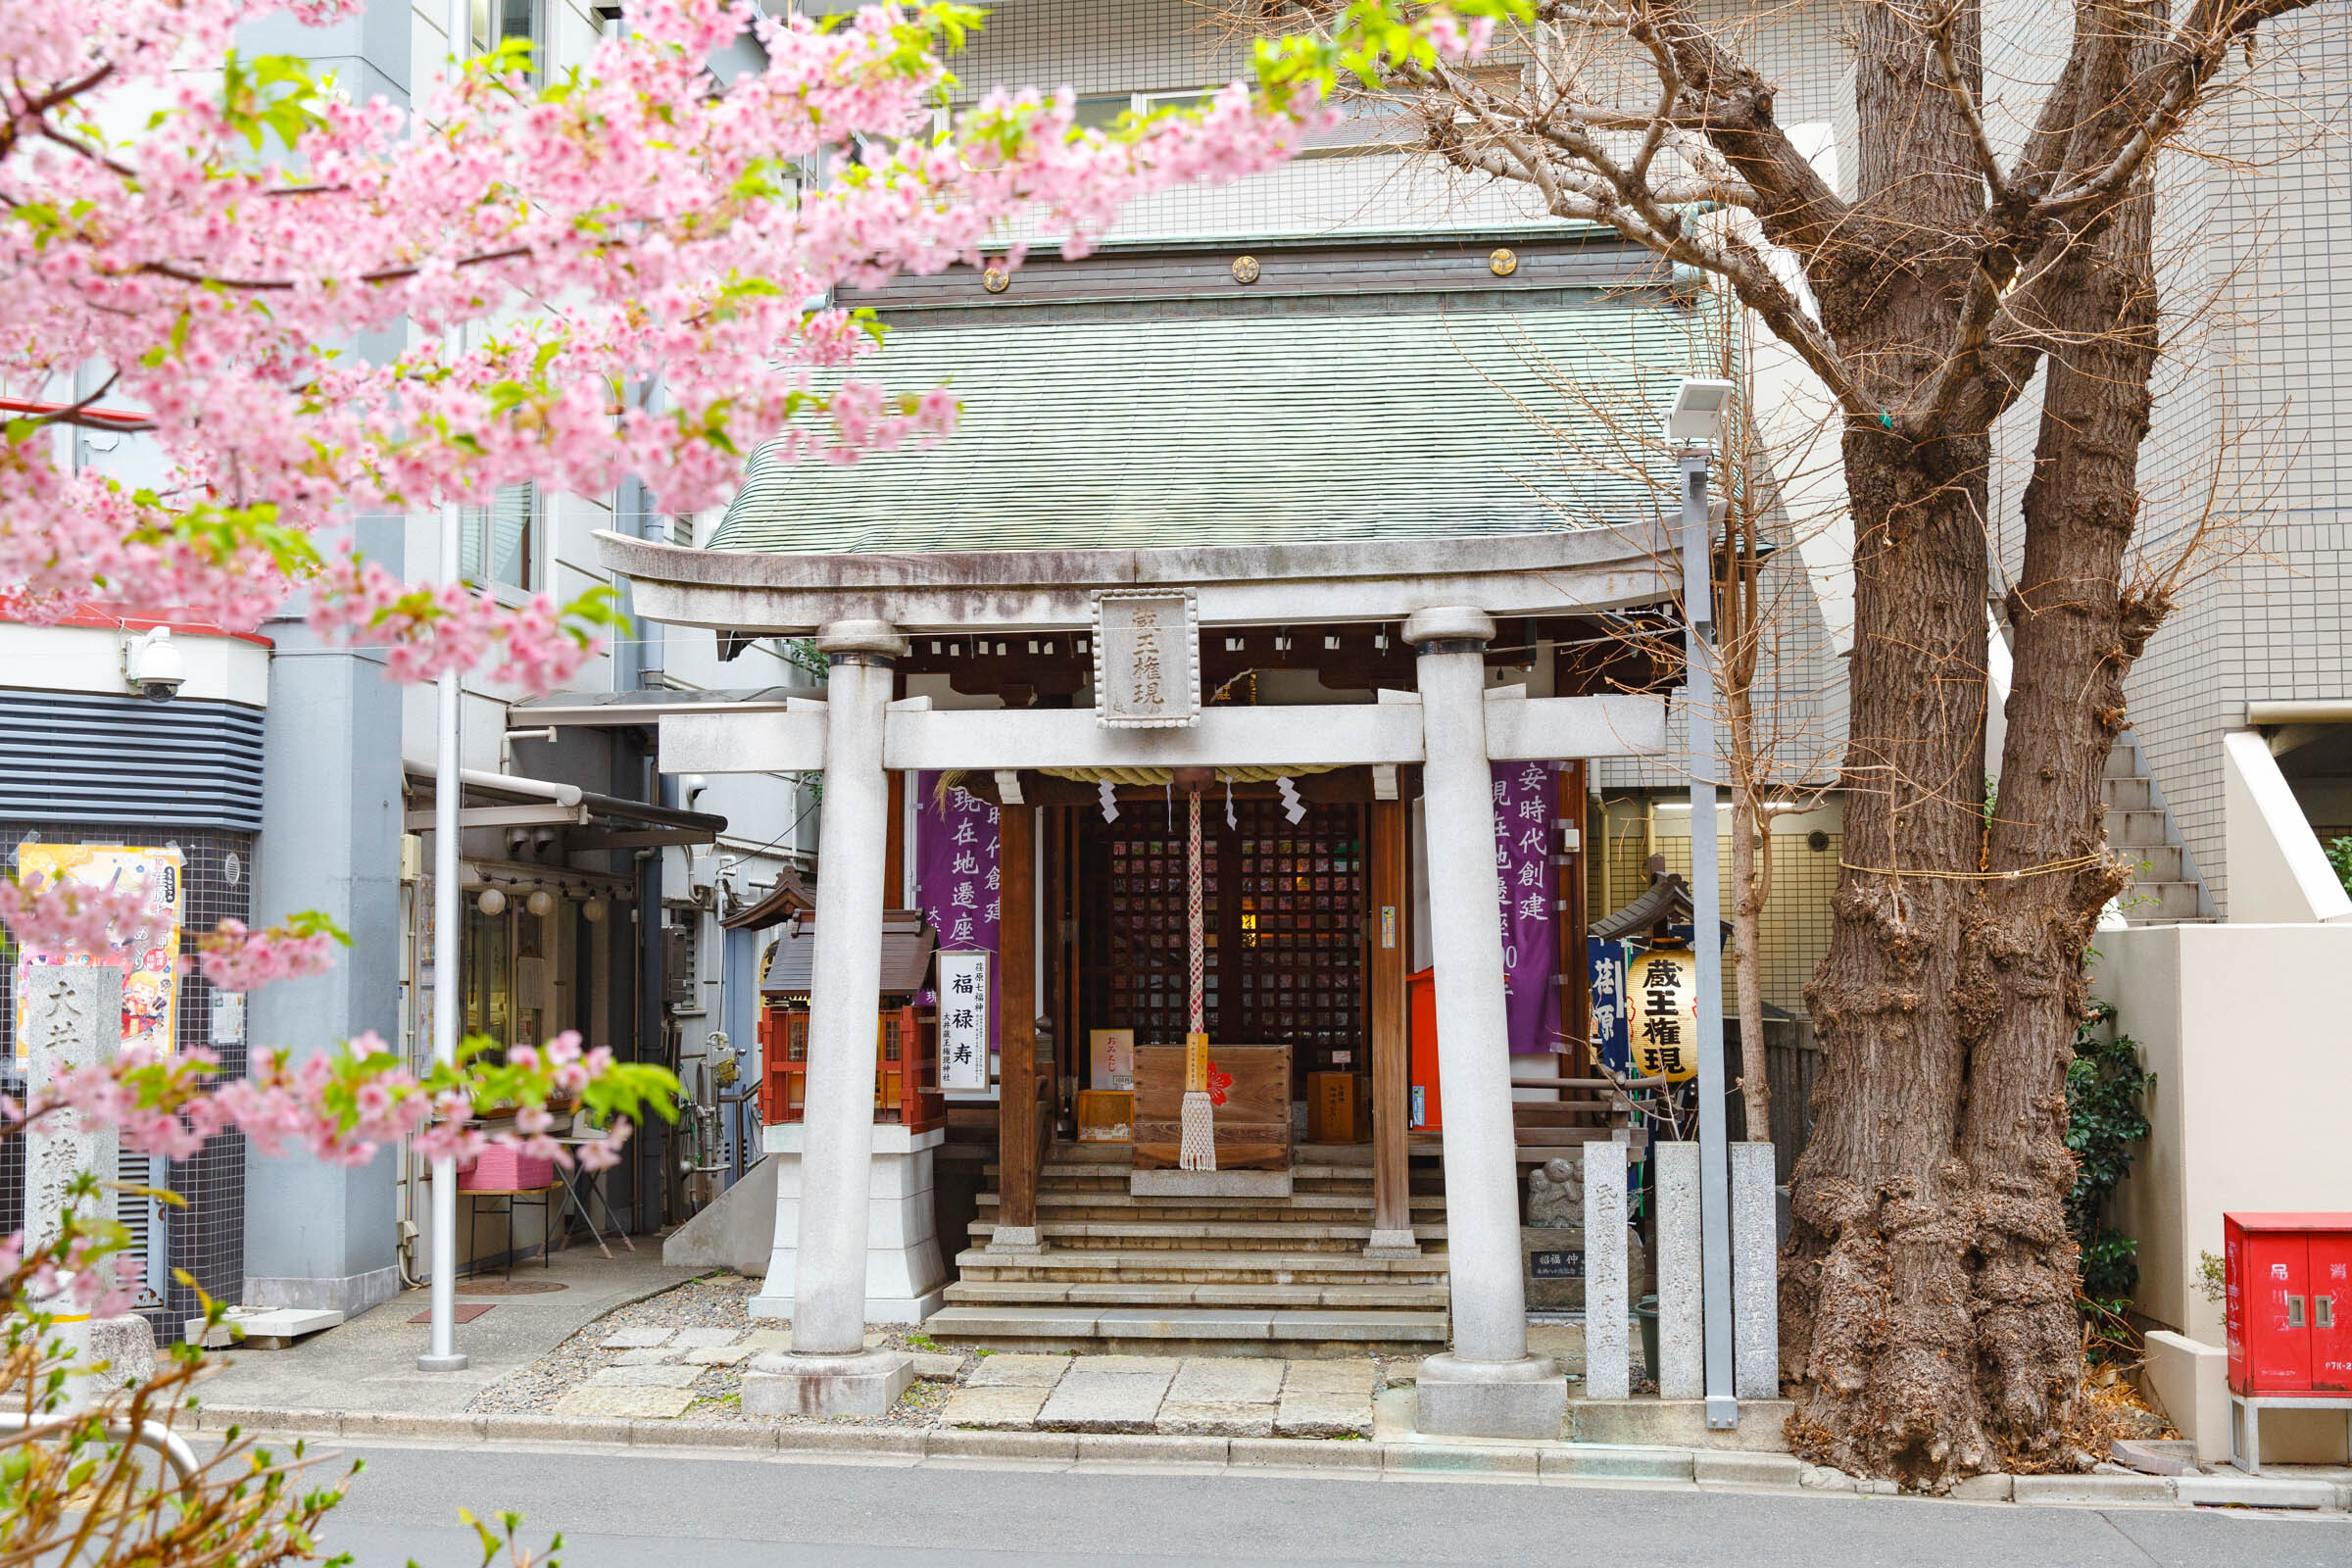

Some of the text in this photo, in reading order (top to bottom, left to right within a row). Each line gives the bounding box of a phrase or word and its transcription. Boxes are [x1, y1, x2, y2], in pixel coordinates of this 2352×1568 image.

[1518, 761, 1548, 920] 安時代創建
[952, 973, 973, 1065] 福禄寿
[975, 961, 984, 1012] 荏原七福神
[1642, 958, 1687, 1074] 蔵王権現
